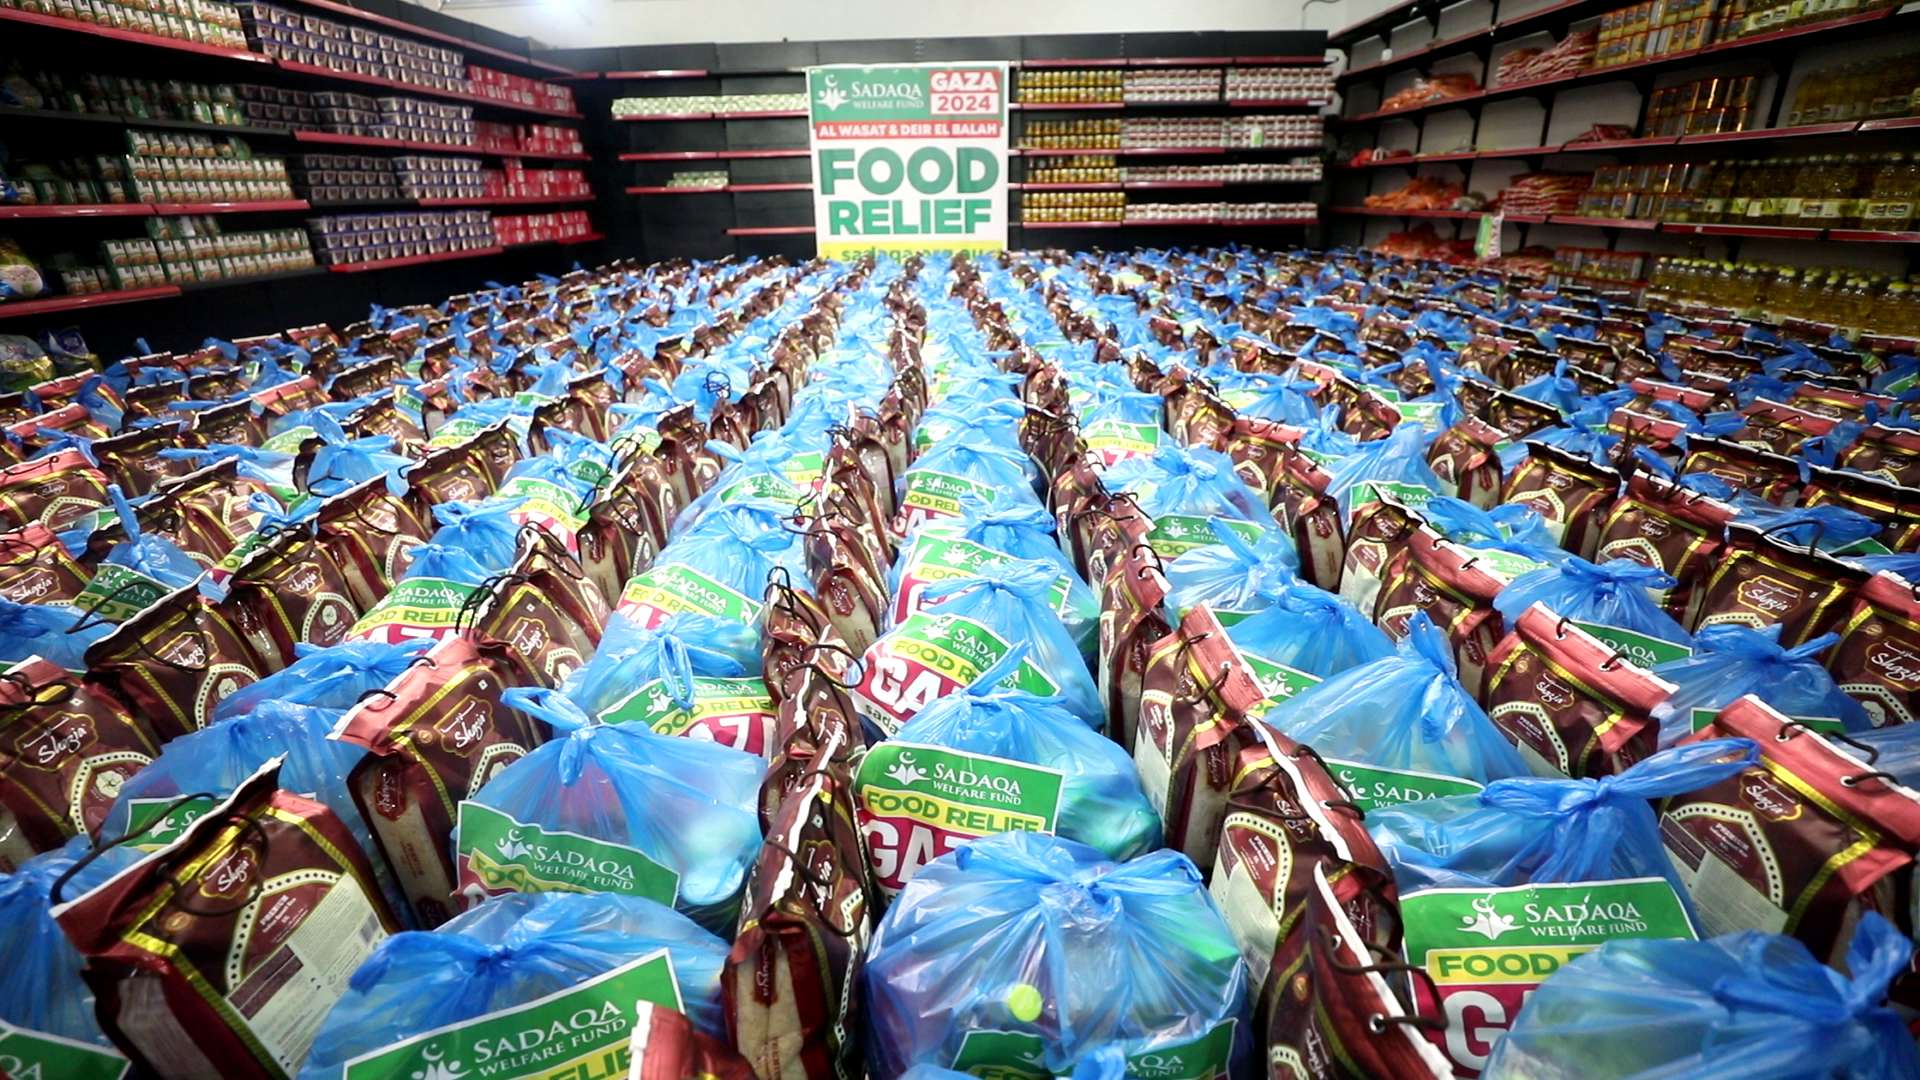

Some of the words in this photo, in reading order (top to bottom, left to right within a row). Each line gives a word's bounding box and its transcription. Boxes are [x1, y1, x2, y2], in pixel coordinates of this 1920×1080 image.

[852, 82, 922, 100] SADAQA
[930, 72, 997, 91] GAZA
[852, 100, 894, 109] WELFARE
[896, 100, 925, 109] FUND
[937, 95, 992, 112] 2024
[819, 124, 836, 137] AL
[838, 124, 888, 136] WASAT
[889, 124, 899, 136] &
[903, 124, 932, 136] DEIR
[934, 124, 950, 136] EL
[951, 123, 997, 136] BALAH
[818, 146, 1000, 195] FOOD
[828, 199, 992, 235] RELIEF
[895, 640, 955, 670] FOOD
[1603, 639, 1657, 662] DAQA
[38, 727, 88, 763] Shazia
[933, 763, 1021, 795] SADAQA
[932, 781, 987, 801] WELFARE
[989, 791, 1022, 806] FUND
[866, 790, 940, 819] FOOD
[945, 808, 1040, 833] RELIEF
[533, 861, 591, 881] WELFARE
[593, 873, 635, 891] FUND
[535, 845, 636, 880] SADAQA
[1524, 902, 1643, 924] SADAQA
[1530, 925, 1607, 937] WELFARE
[1609, 920, 1648, 934] FUND
[1438, 953, 1559, 978] FOOD
[473, 1000, 624, 1065] SADAQA
[479, 1042, 566, 1078] WELFARE
[571, 1019, 627, 1052] FUND
